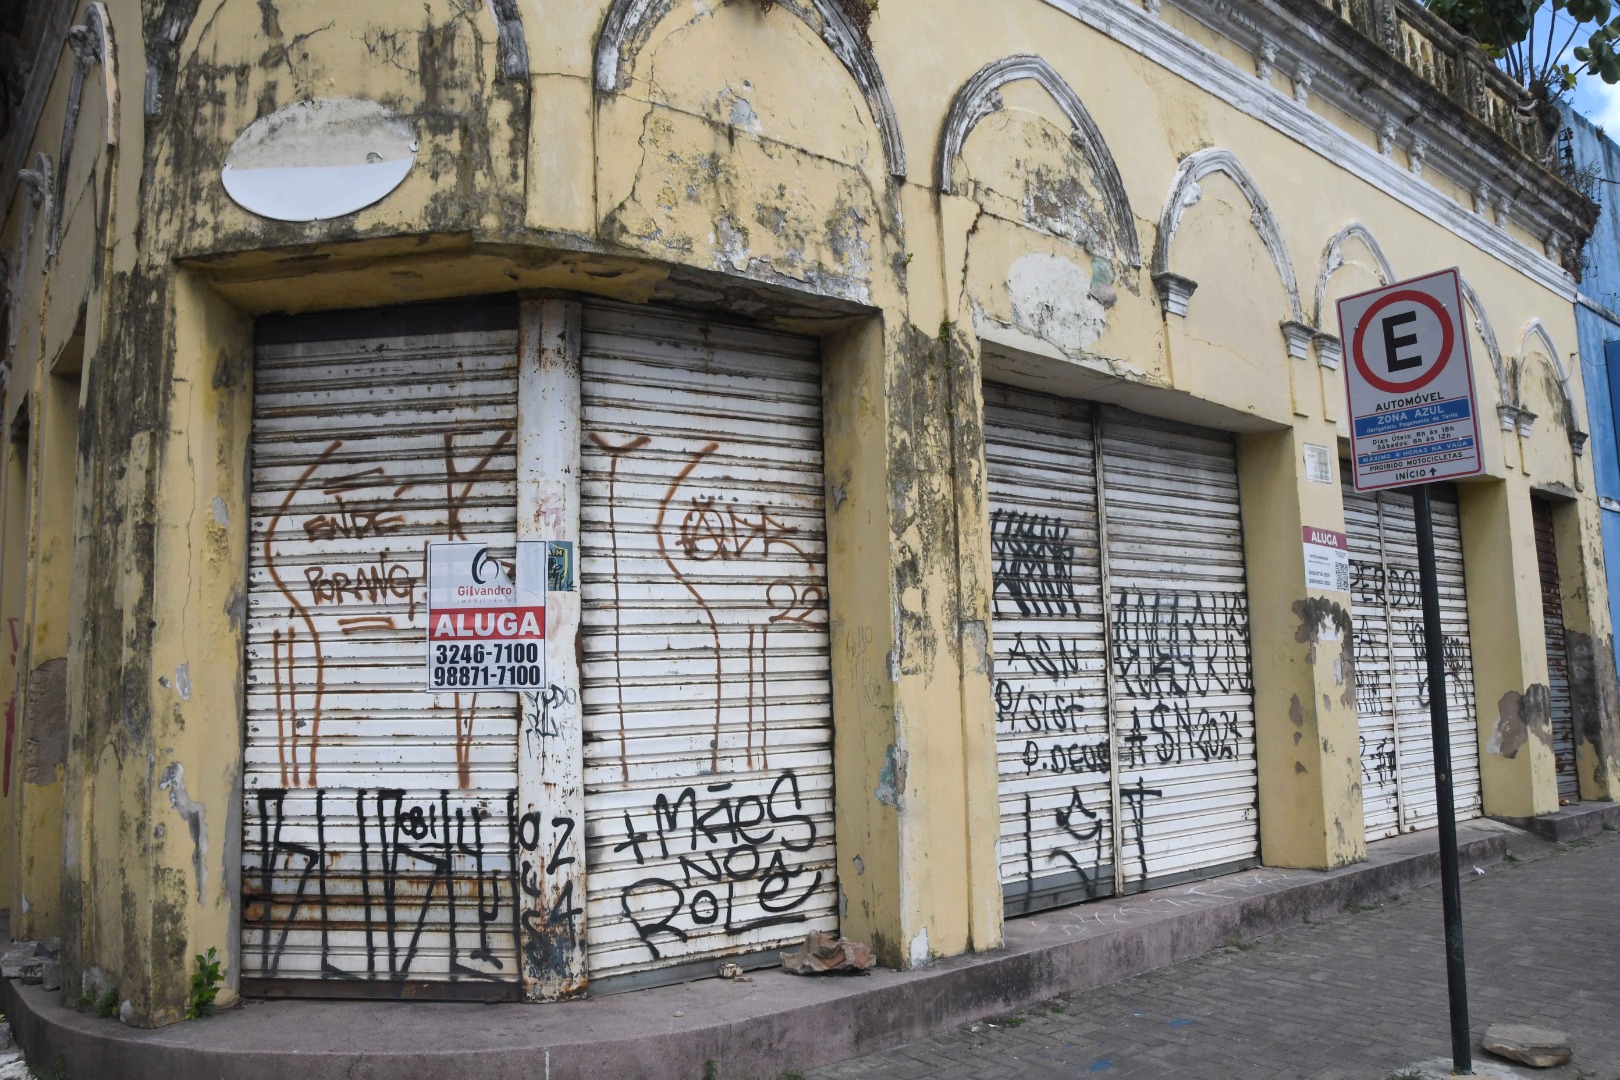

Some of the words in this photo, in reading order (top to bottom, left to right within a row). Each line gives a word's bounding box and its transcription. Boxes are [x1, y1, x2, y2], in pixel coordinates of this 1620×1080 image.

[1382, 311, 1422, 373] E
[1375, 391, 1445, 412] AUTOMÓVEL
[1377, 412, 1408, 425] ZONA
[1414, 405, 1445, 418] AZUL
[1391, 433, 1413, 442] Úteis:
[1441, 425, 1455, 433] 18h
[1377, 440, 1410, 451] Sábados:
[1403, 447, 1428, 457] HORAS
[1446, 441, 1468, 449] VAGA
[1369, 461, 1403, 472] PROIBIDO
[1406, 452, 1463, 465] MOTOCICLETAS
[1395, 468, 1426, 480] INÍCIO
[1311, 530, 1338, 547] ALUGA
[457, 585, 512, 597] Gilvandro
[434, 611, 541, 638] ALUGA
[436, 642, 538, 665] 3246-7100
[434, 664, 541, 687] 98871-7100
